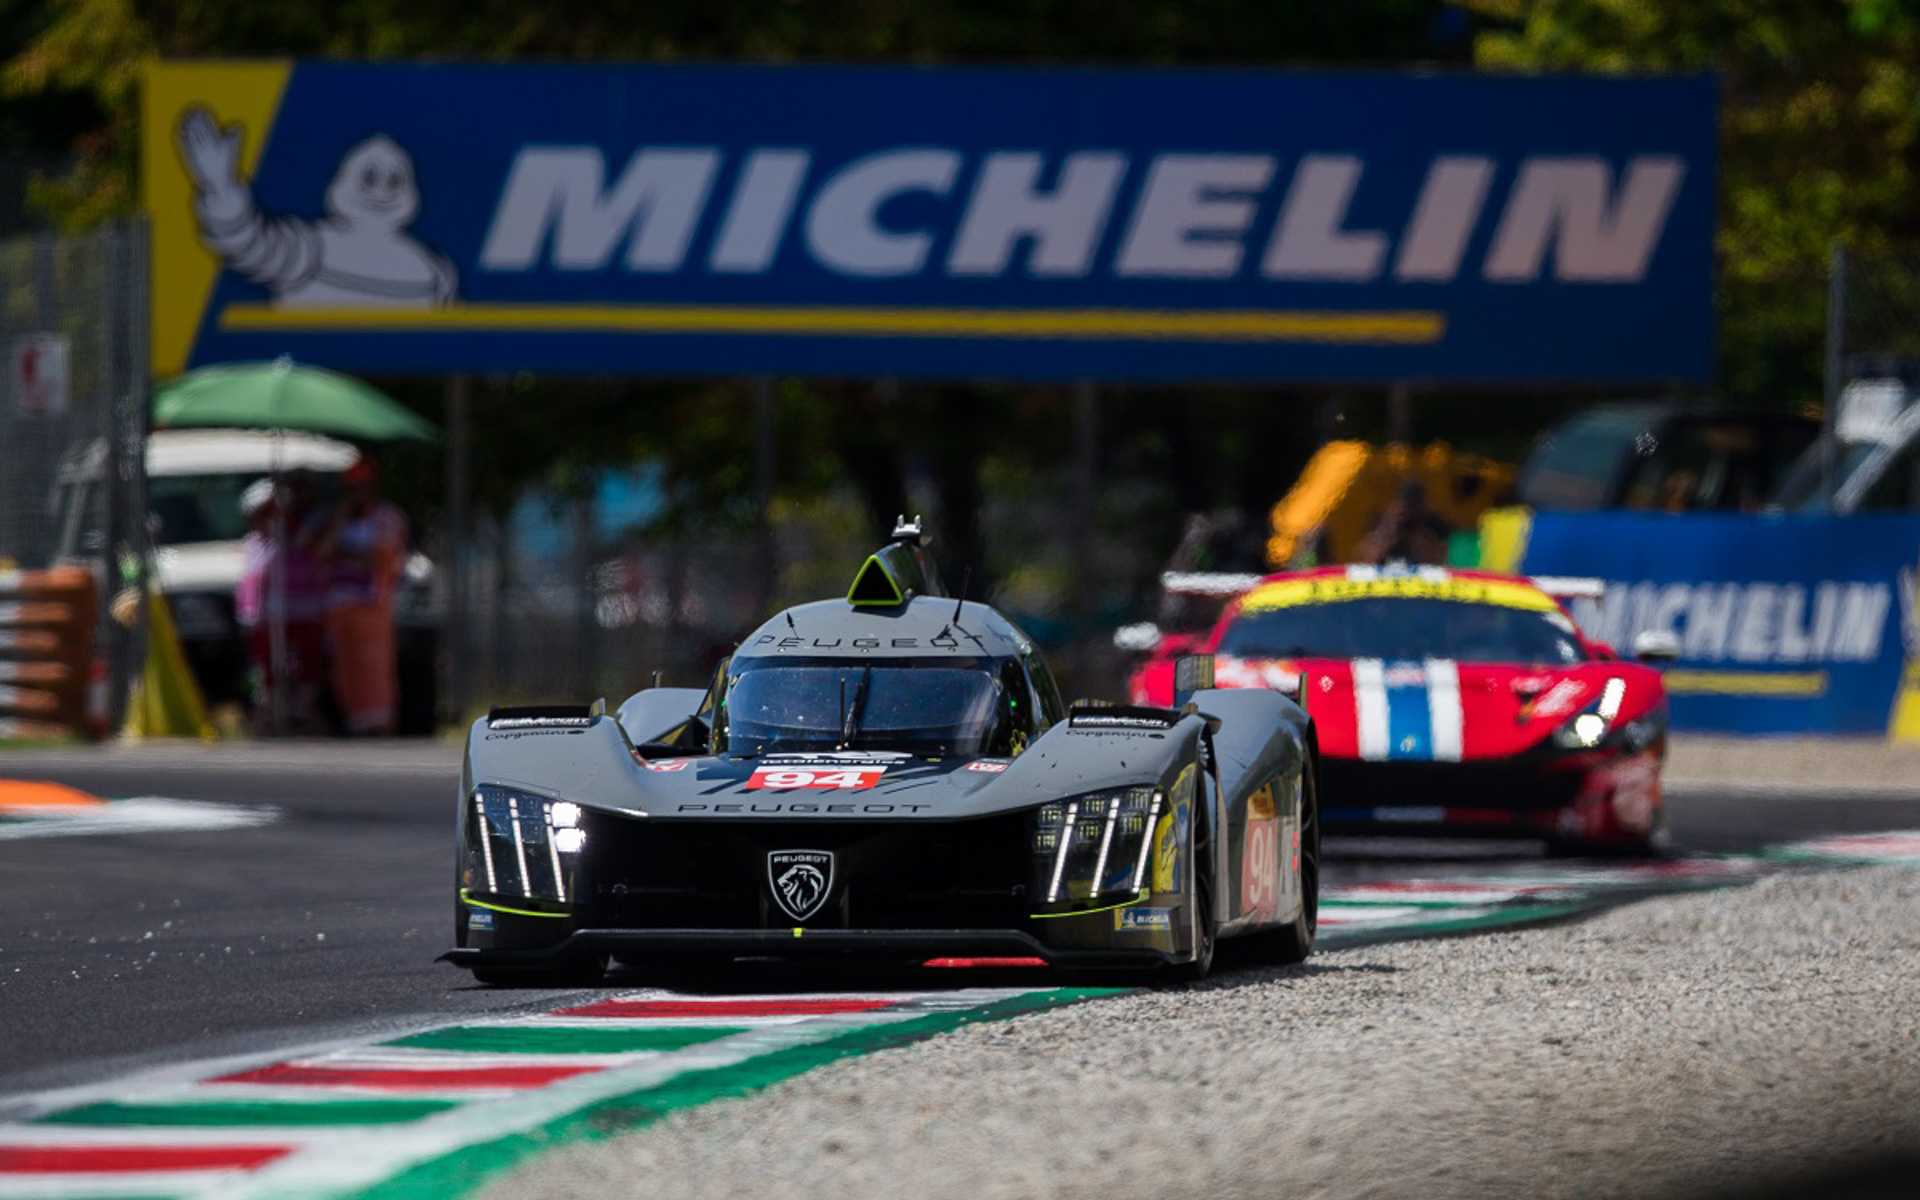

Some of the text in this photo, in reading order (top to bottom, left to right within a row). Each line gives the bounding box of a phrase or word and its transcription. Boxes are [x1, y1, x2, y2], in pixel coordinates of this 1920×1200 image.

[479, 146, 1686, 284] MICHELIN
[1571, 582, 1891, 661] MICHELIN
[753, 634, 983, 649] PEUGEOT
[485, 729, 566, 741] Capgemini
[1066, 729, 1147, 740] Capgemini
[763, 772, 865, 789] 94
[677, 803, 932, 813] PEUGEOT
[773, 854, 829, 863] PEUGEOT
[1249, 826, 1274, 905] 94
